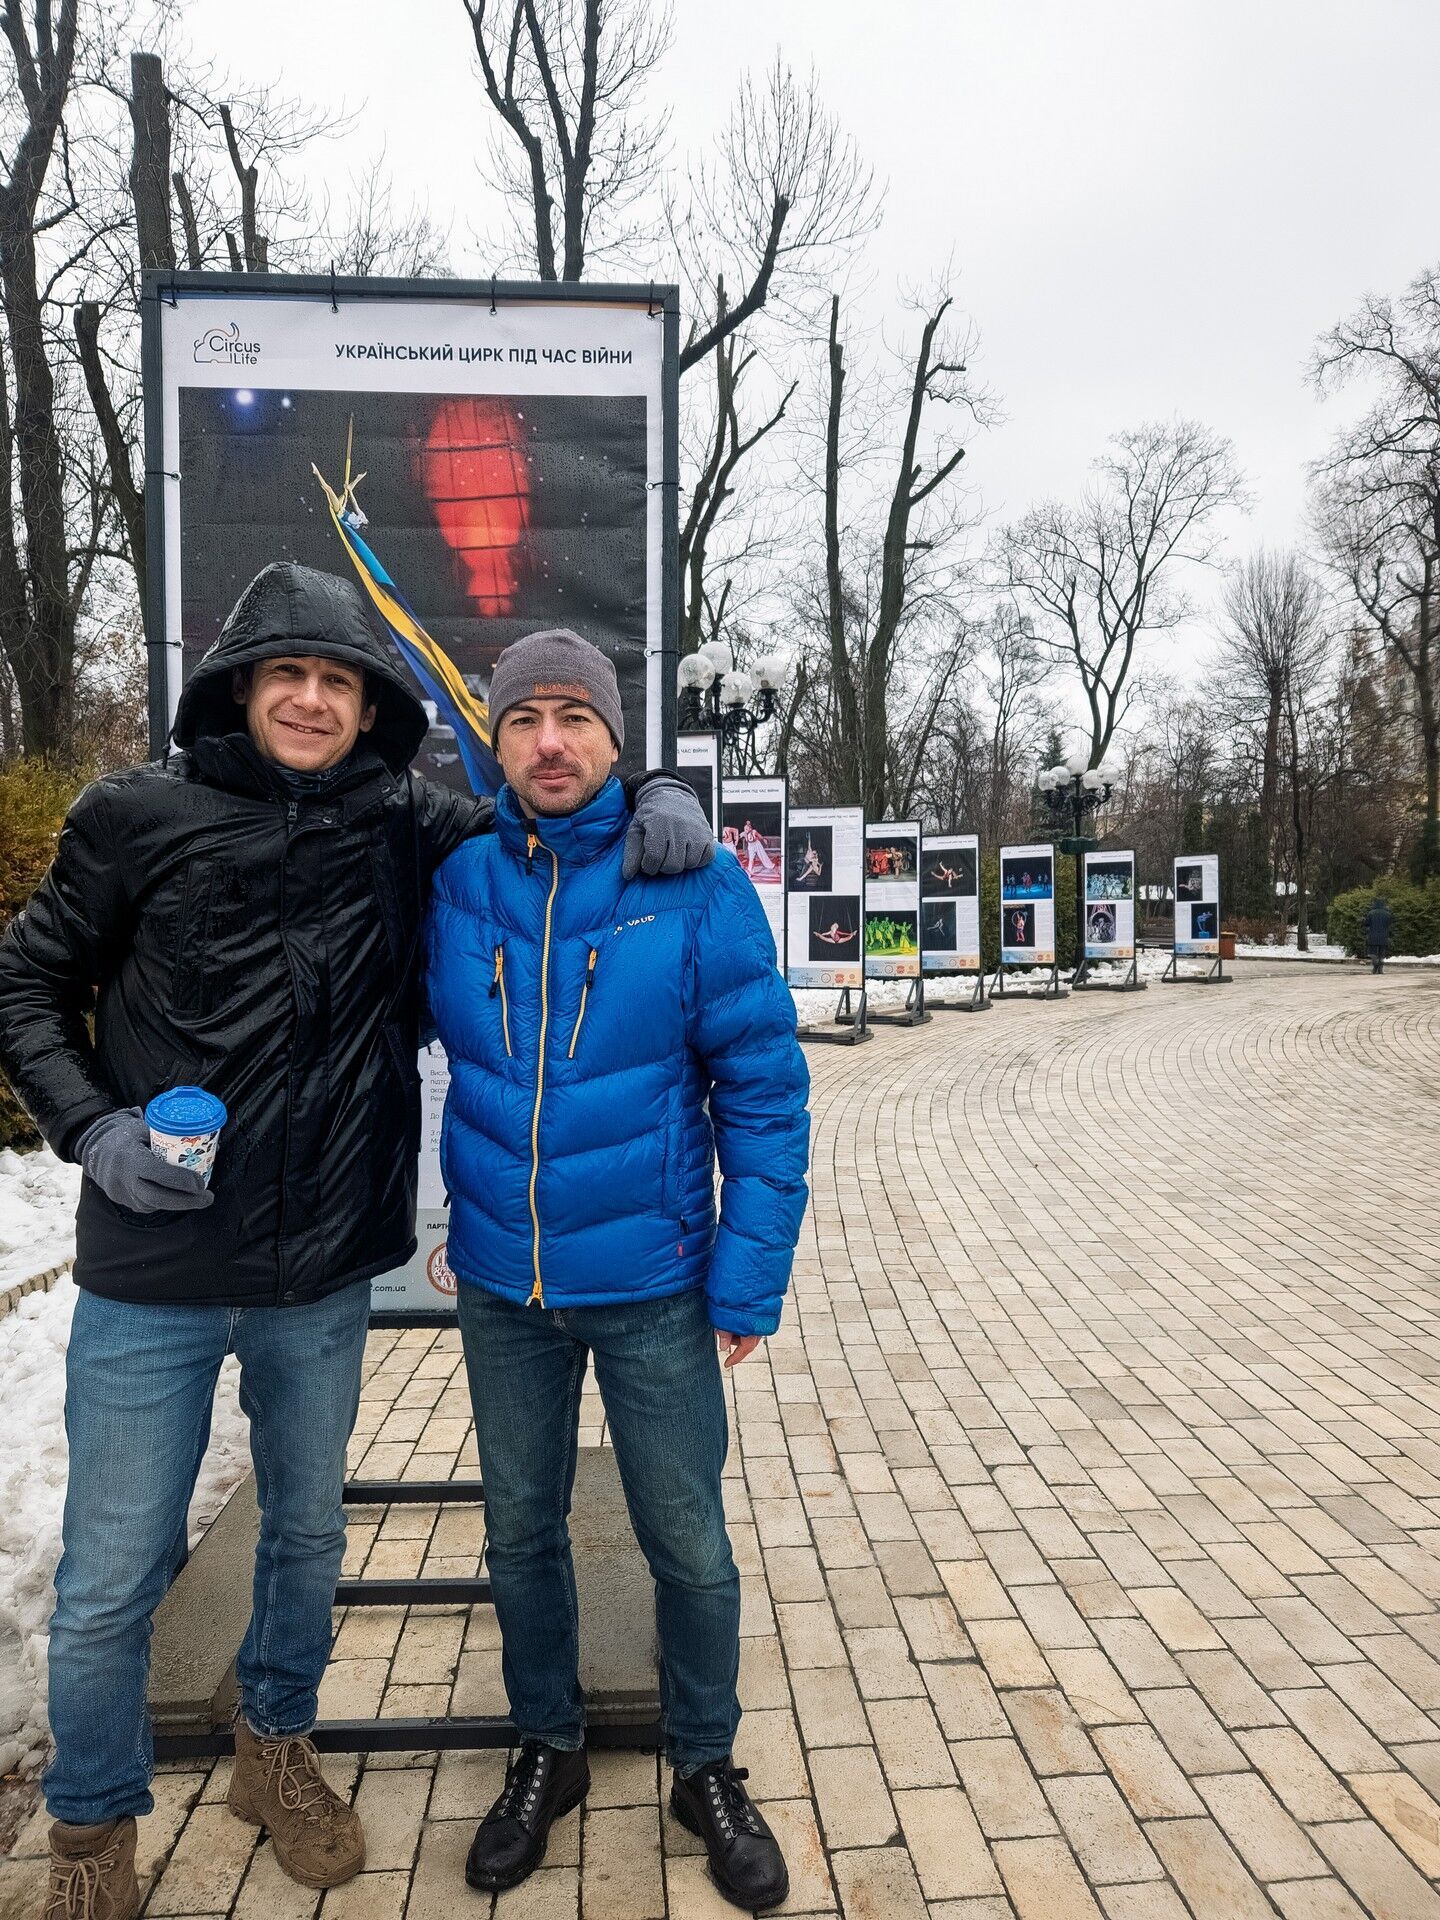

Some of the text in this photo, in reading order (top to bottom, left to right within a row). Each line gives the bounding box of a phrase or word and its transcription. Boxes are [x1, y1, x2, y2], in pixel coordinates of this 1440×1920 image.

[209, 335, 261, 353] Circus
[233, 352, 258, 365] Life
[334, 342, 632, 365] УКРАЇНСЬКИЙ ЦИРК ПІД ЧАС ВІЙНИ
